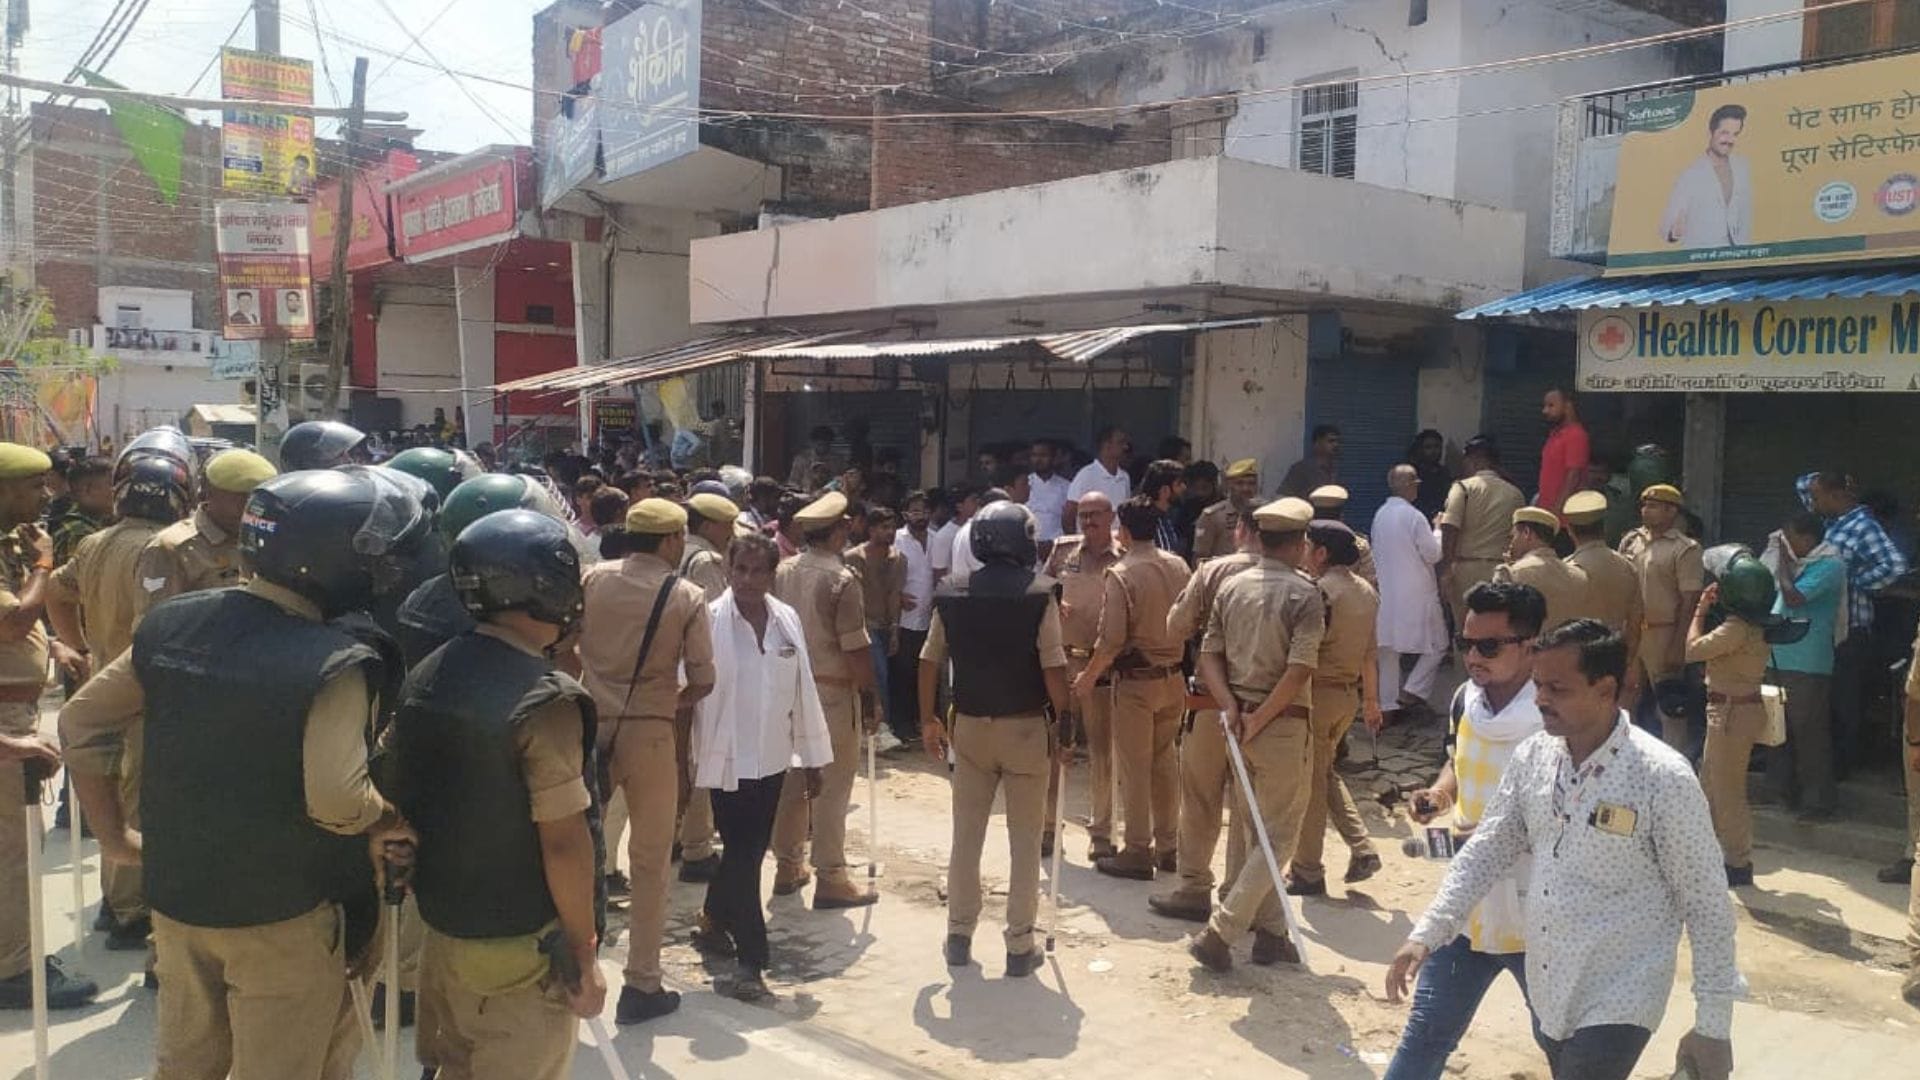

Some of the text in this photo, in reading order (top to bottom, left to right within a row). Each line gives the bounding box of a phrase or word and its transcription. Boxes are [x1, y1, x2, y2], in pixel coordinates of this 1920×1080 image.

[1788, 89, 1920, 130] पेट साफ हो
[1781, 145, 1819, 173] पूरा
[1637, 308, 1740, 357] Health
[1753, 305, 1877, 356] Corner
